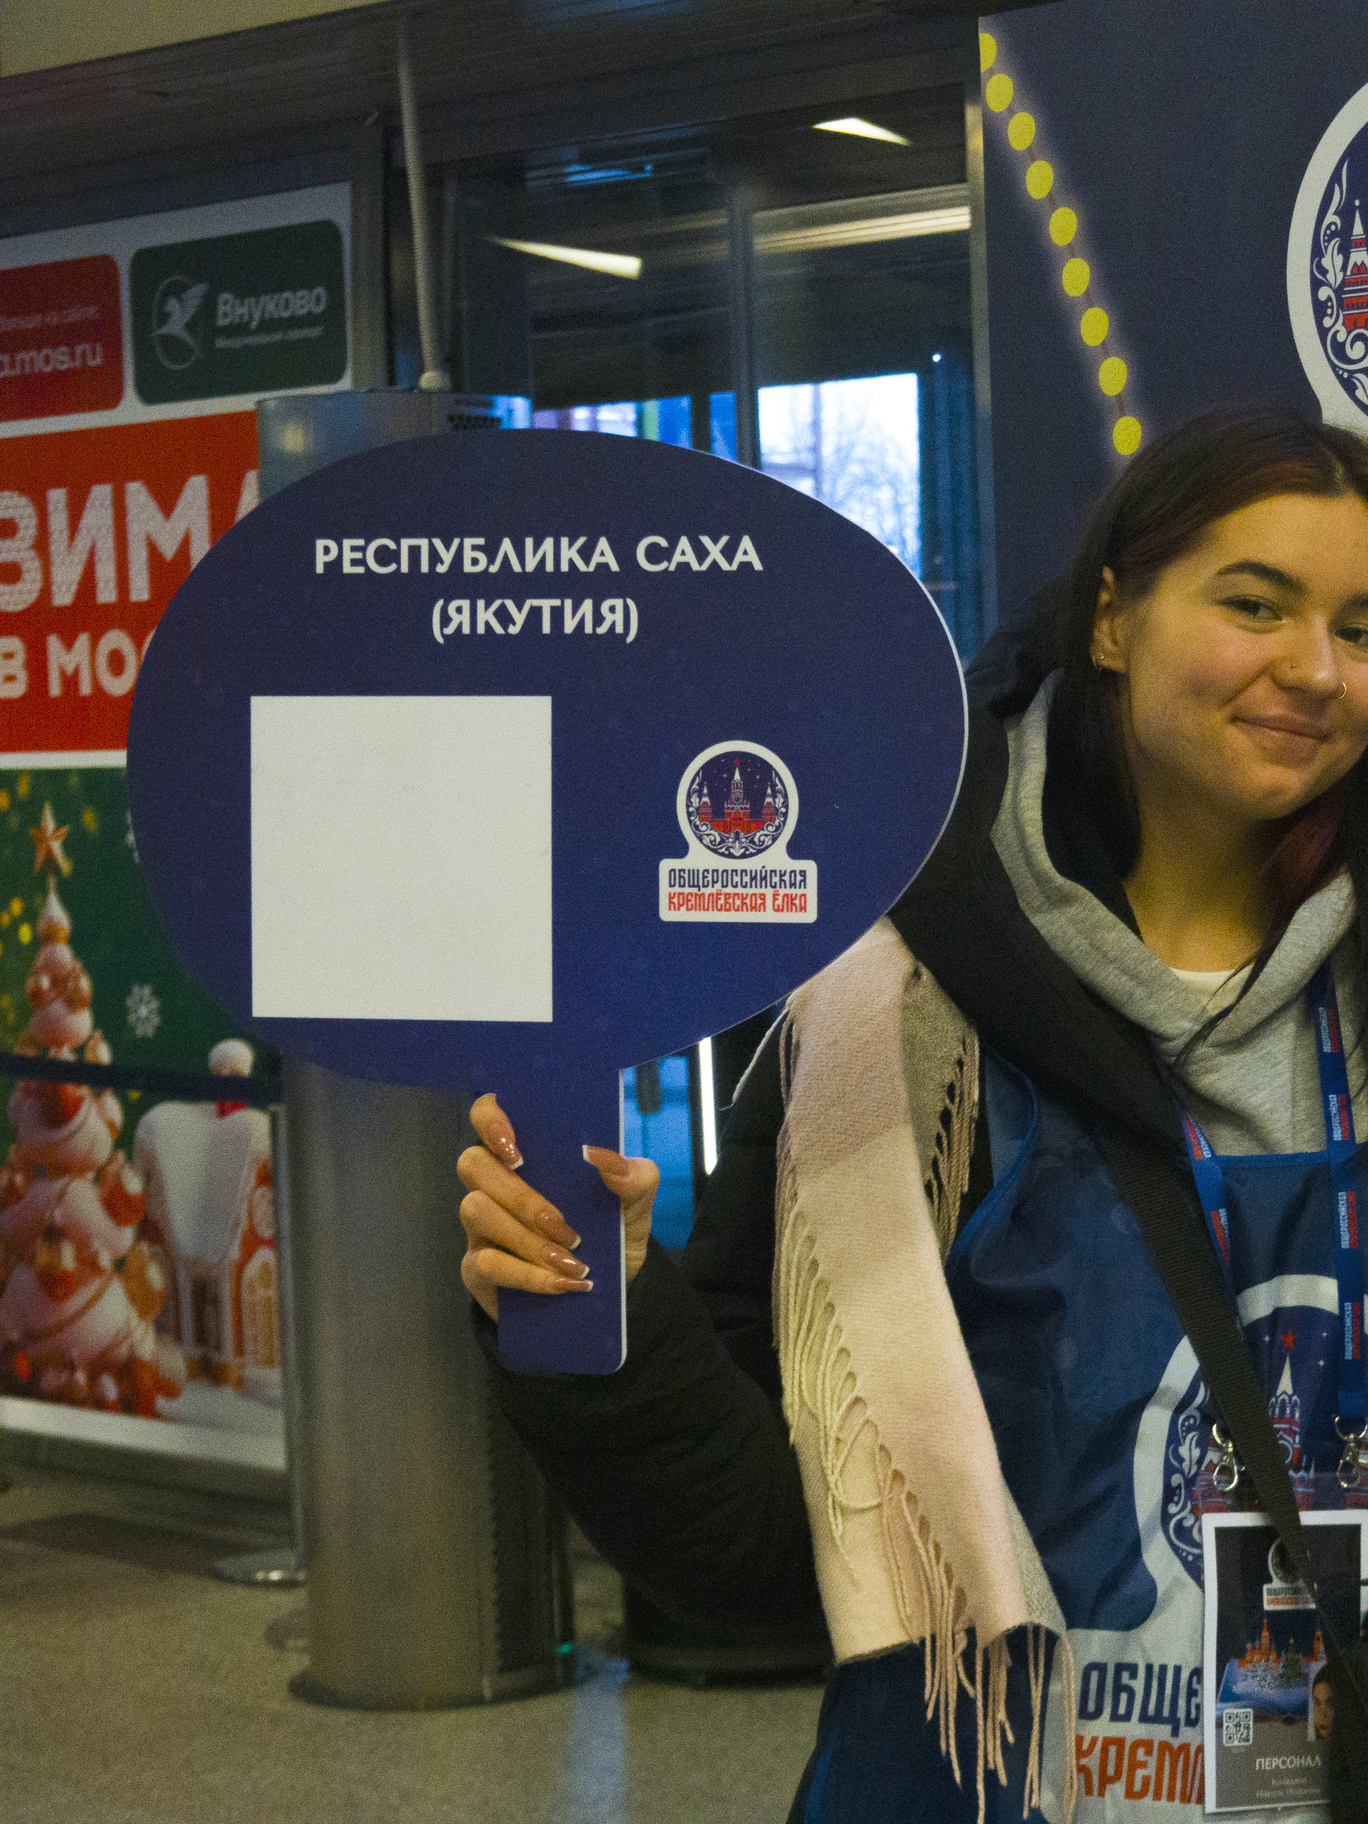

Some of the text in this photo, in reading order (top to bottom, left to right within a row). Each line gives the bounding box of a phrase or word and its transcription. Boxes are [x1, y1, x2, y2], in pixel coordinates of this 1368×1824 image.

[217, 286, 326, 330] Внуково
[0, 469, 259, 612] ЗИМ
[315, 535, 764, 574] РЕСПУБЛИКА САХА
[432, 598, 639, 645] (ЯКУТИЯ)
[47, 628, 157, 697] МО
[668, 865, 807, 892] ОБЩЕРОССИЙСКАЯ
[668, 889, 807, 913] КРЕМЛЁВСКАЯ ЁЛКА
[1078, 1661, 1203, 1738] ОБЩЕ
